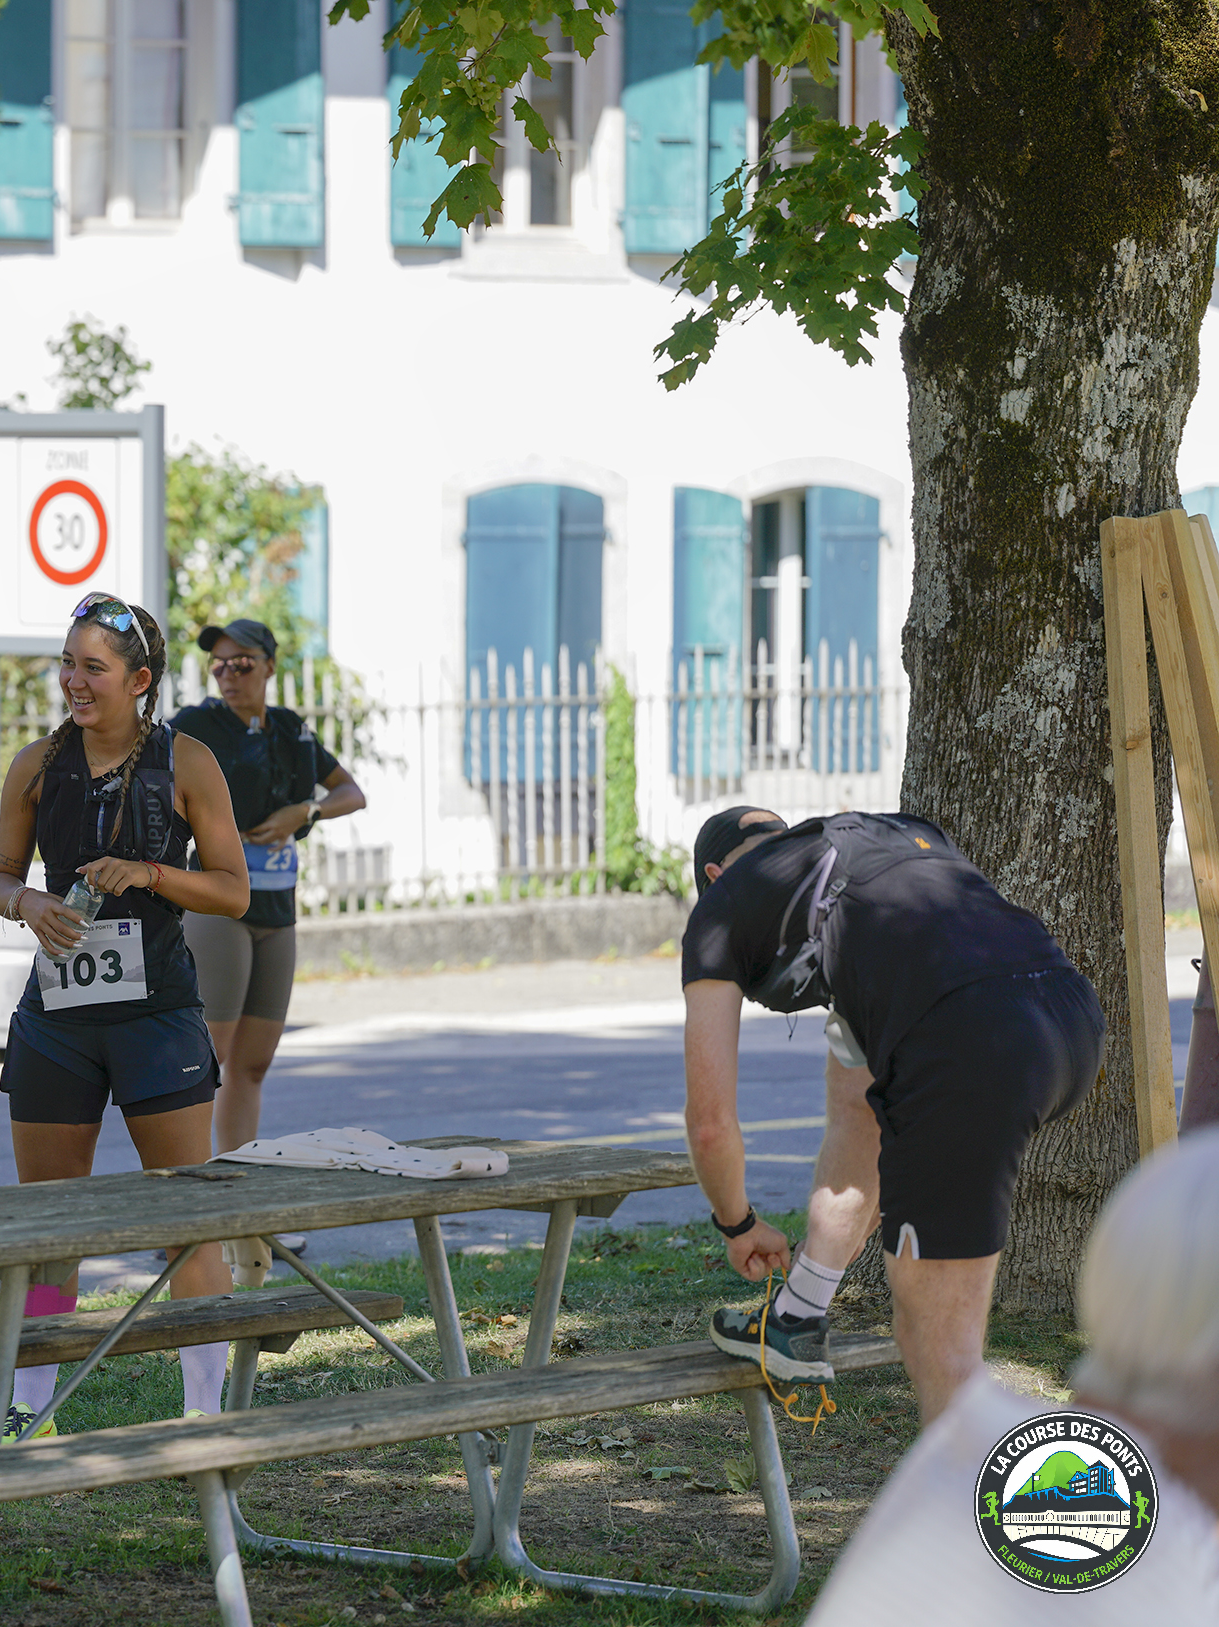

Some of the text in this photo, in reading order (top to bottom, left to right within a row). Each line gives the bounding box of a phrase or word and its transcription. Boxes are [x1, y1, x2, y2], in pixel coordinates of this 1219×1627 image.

[45, 448, 89, 471] ZONE
[52, 512, 86, 552] 30
[265, 847, 292, 870] 23
[53, 949, 124, 990] 103
